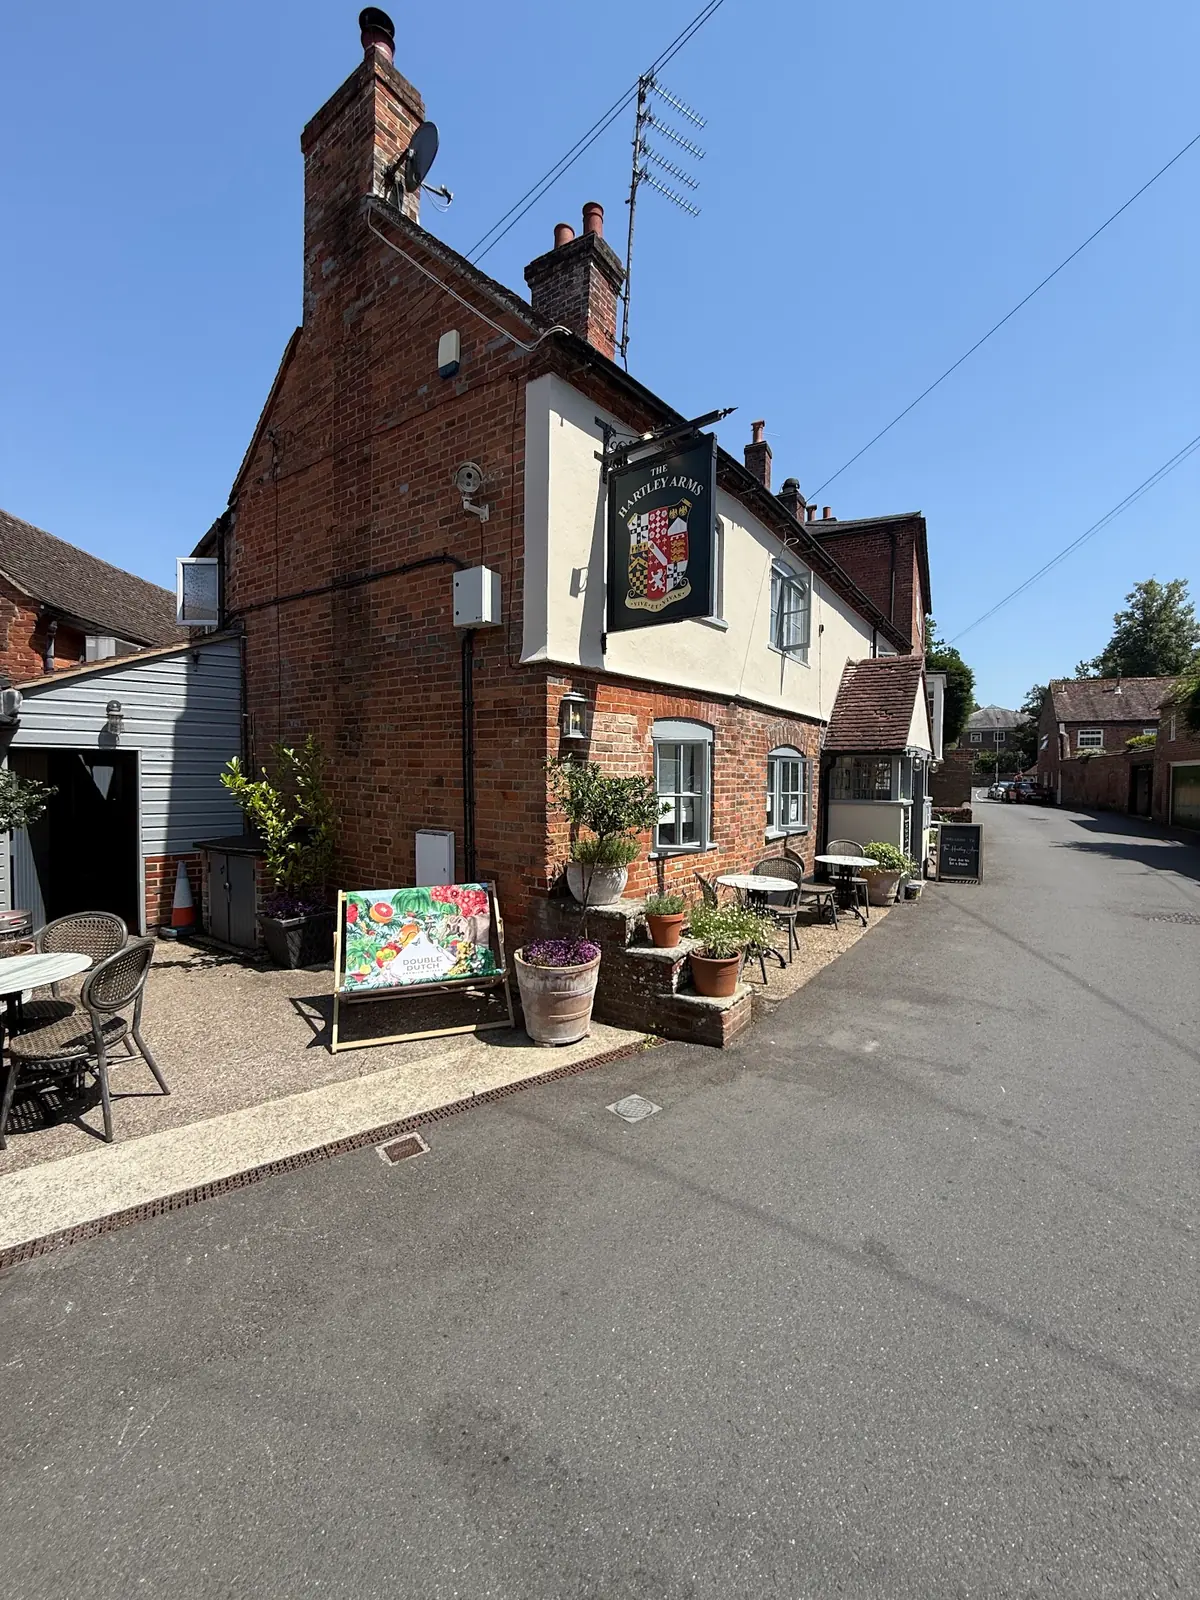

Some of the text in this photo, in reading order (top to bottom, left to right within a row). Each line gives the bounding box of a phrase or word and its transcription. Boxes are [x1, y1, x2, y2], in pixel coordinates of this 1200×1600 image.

[650, 463, 668, 477] THE
[618, 475, 704, 518] HARTLEY ARMS
[402, 956, 442, 965] DOUBLE
[406, 962, 440, 971] DUTCH
